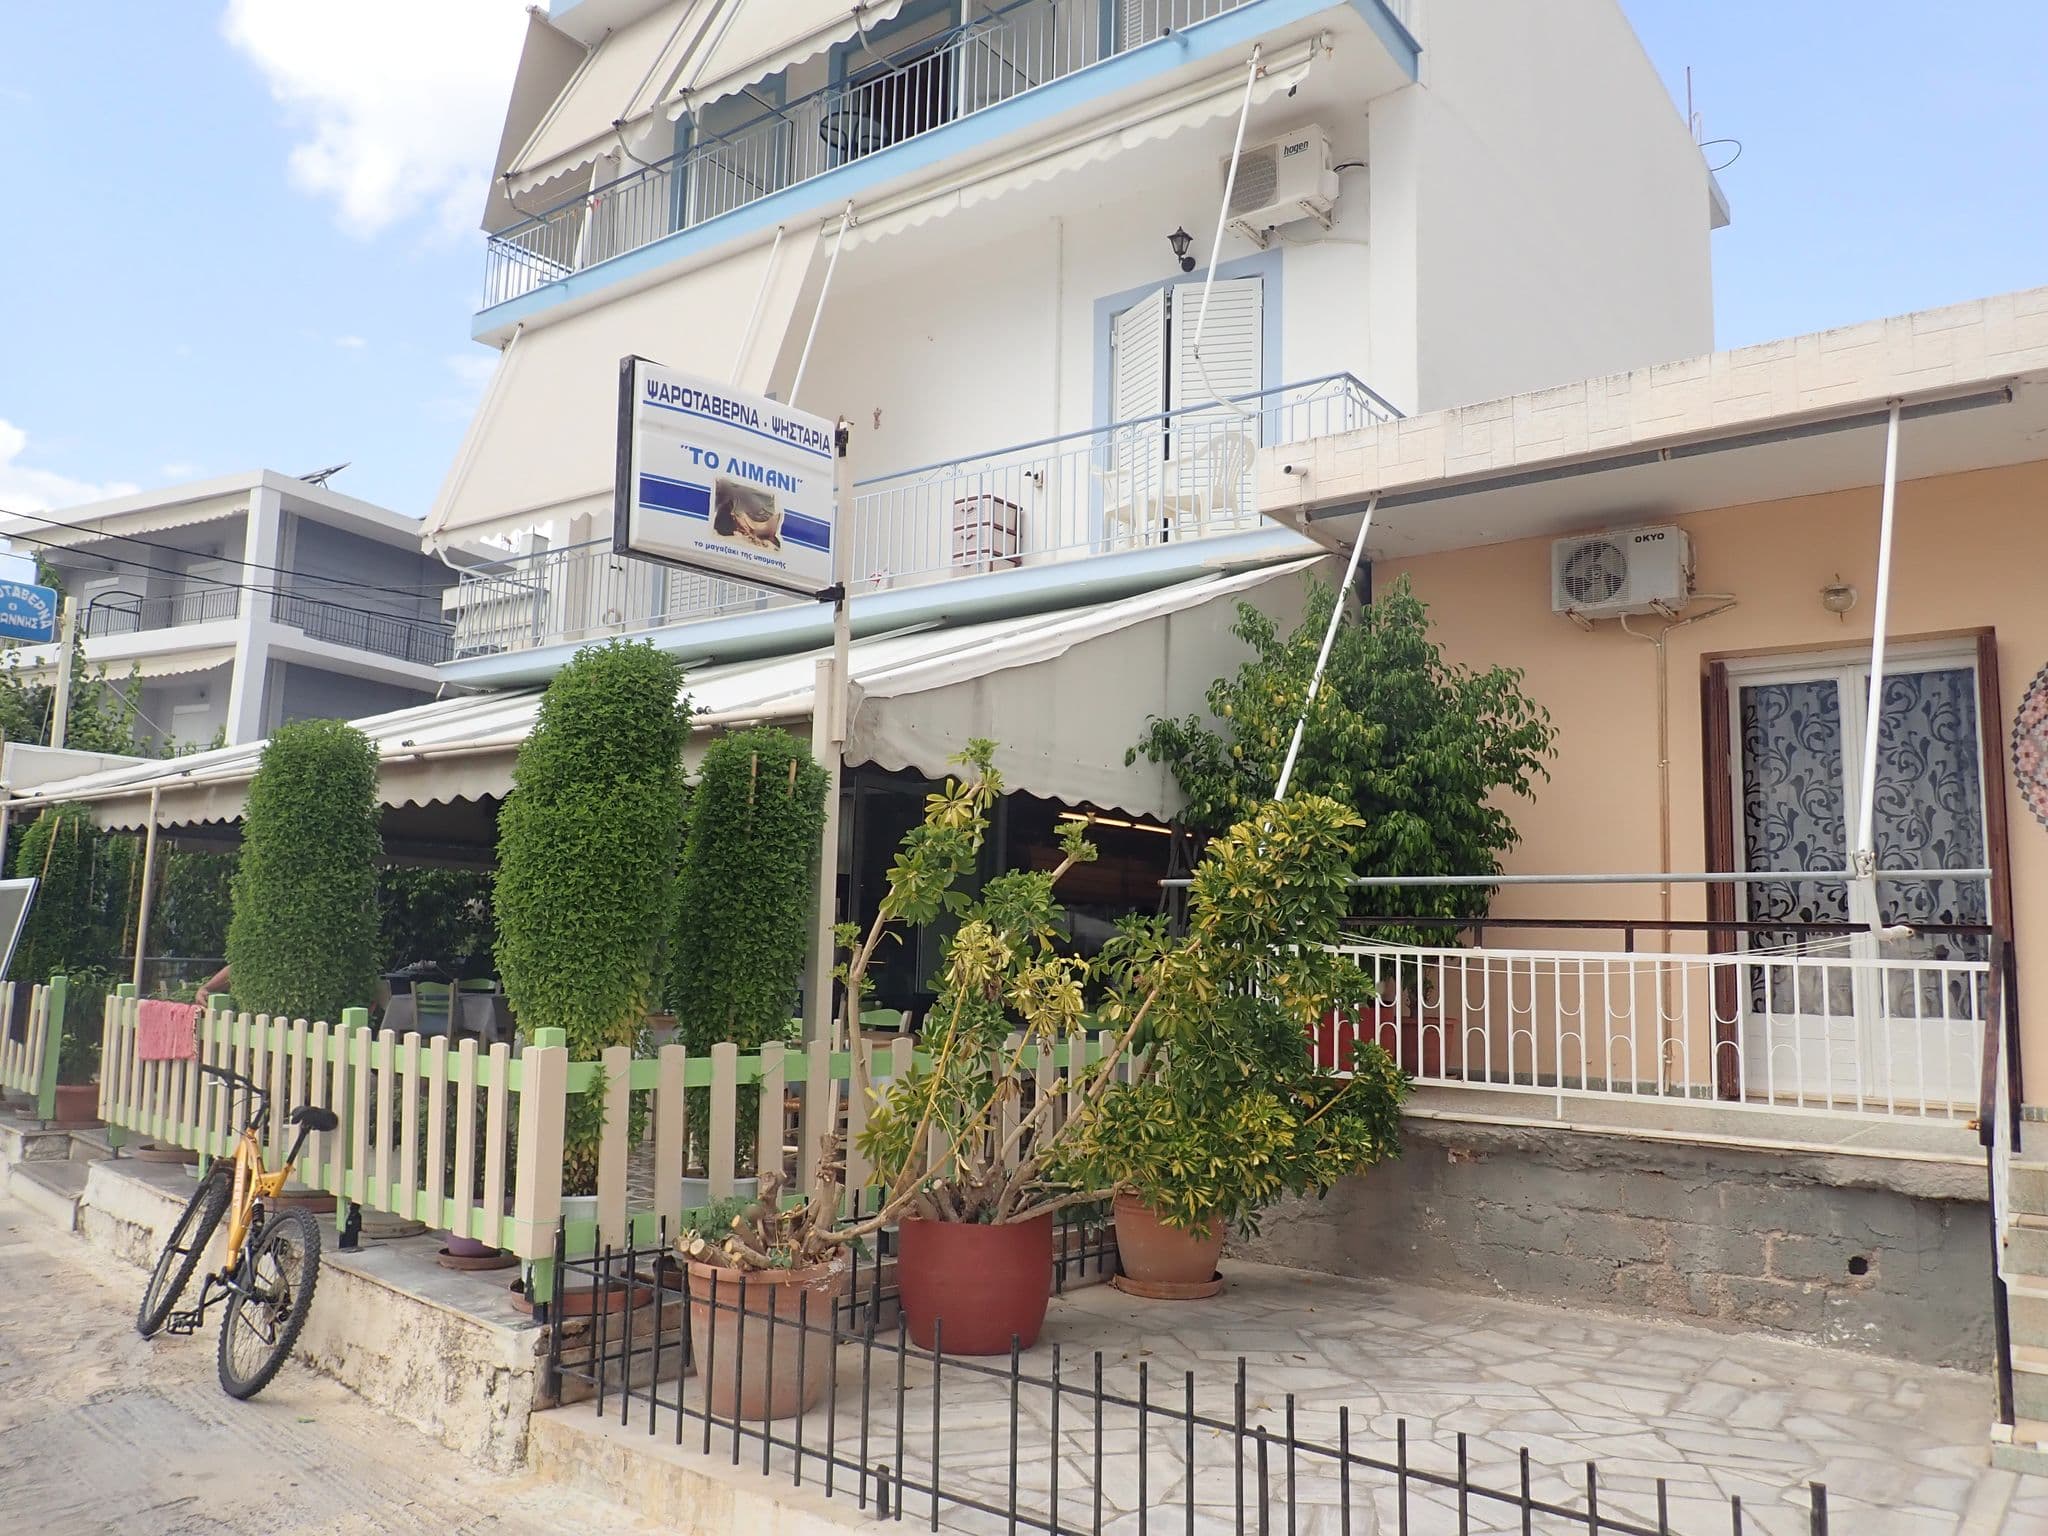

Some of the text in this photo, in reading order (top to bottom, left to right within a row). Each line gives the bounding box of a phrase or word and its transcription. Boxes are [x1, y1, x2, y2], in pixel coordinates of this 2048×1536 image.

[647, 379, 831, 453] ΨΑΡΟΤΑΒΕΡΝΑ ΨΗΣΤΑΡΙΑ
[1635, 532, 1665, 543] OKYO
[740, 551, 752, 560] της
